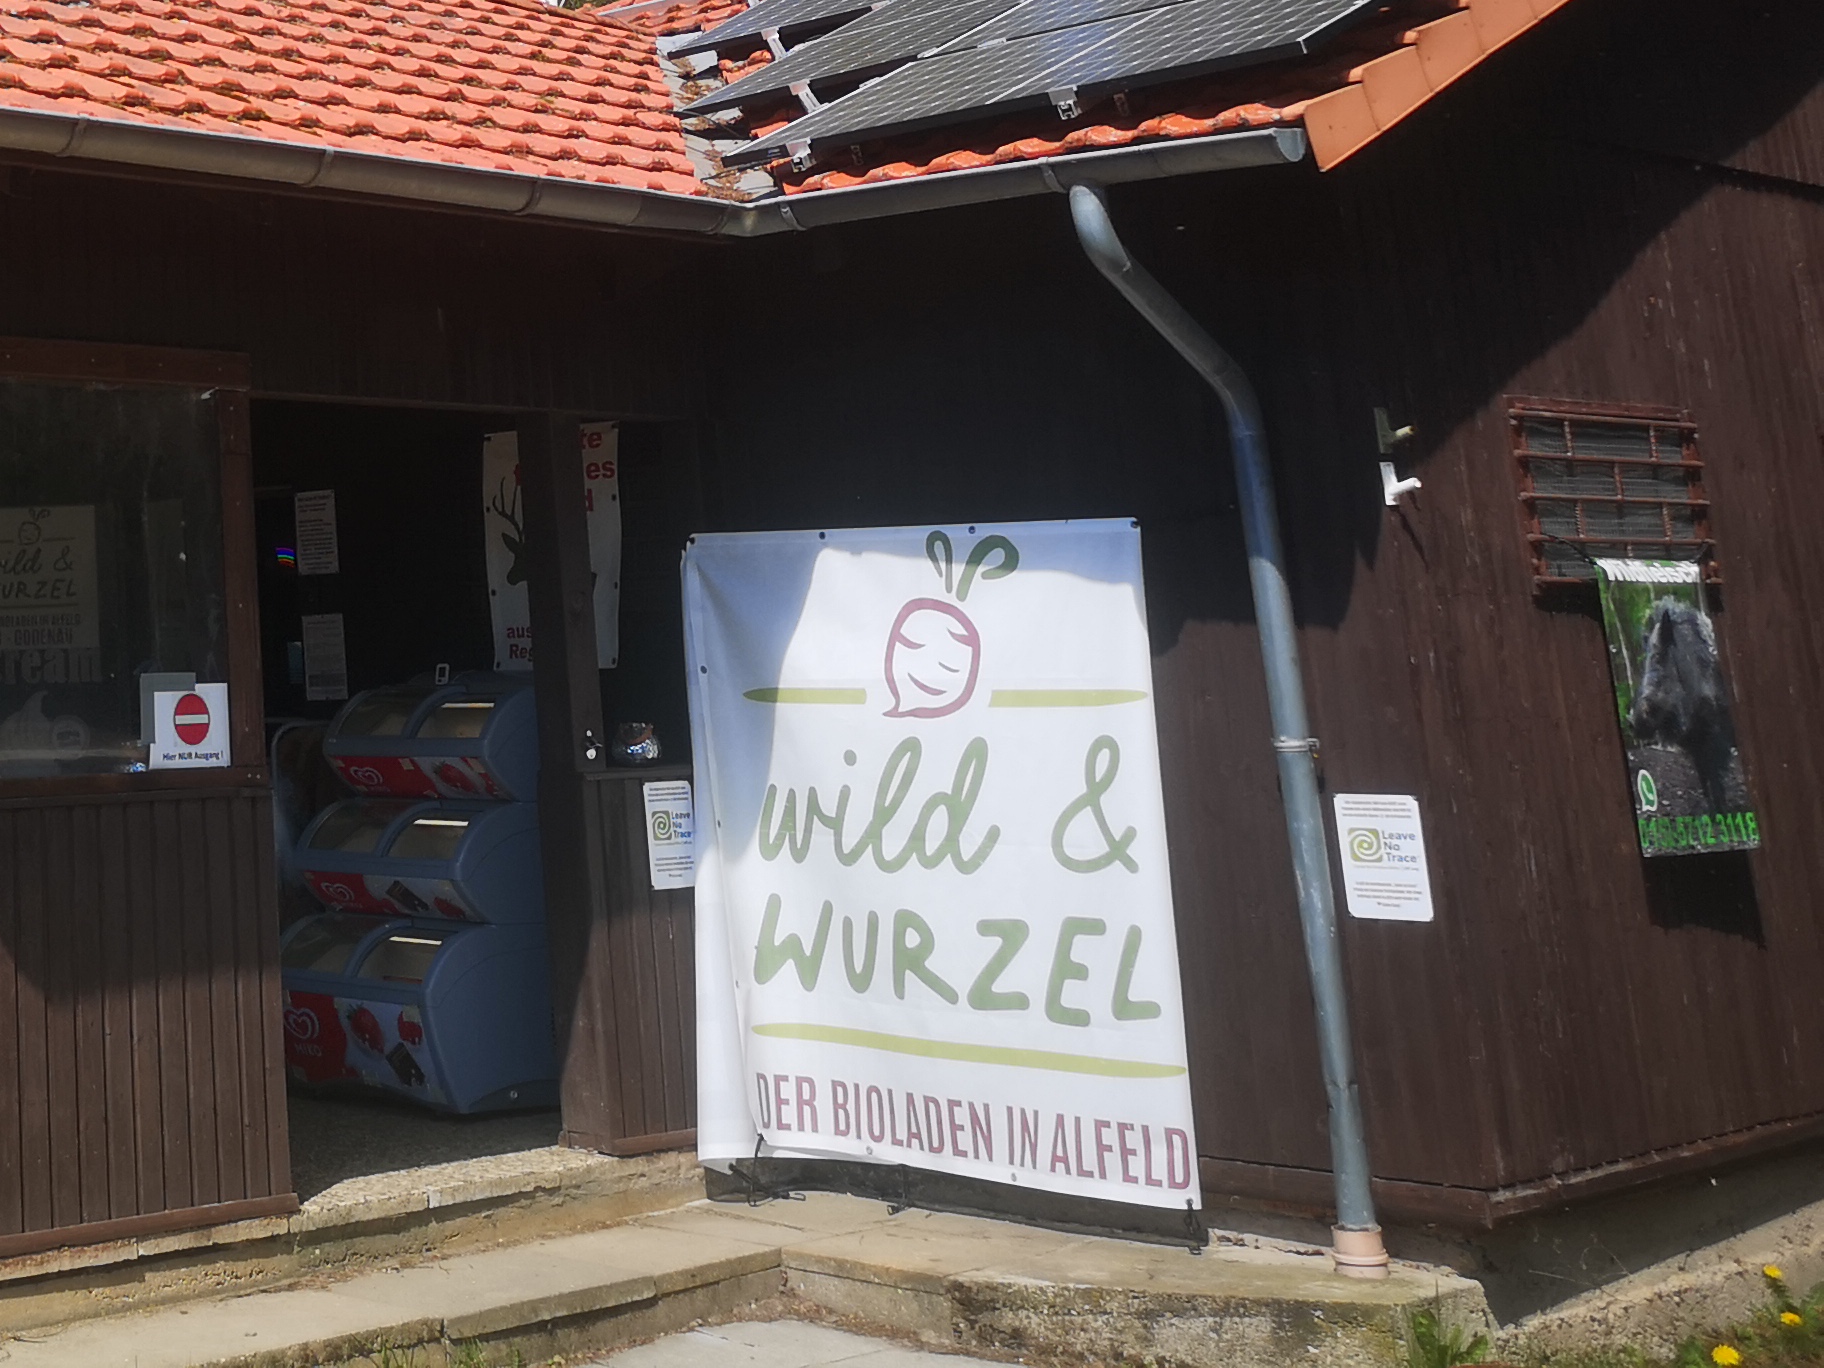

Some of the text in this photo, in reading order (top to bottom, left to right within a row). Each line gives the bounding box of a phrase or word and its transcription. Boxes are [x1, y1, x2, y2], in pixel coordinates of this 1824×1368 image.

[53, 545, 73, 571] &
[162, 752, 177, 761] Hier
[178, 752, 193, 760] NUR
[194, 751, 220, 761] Ausgang
[758, 734, 1140, 876] wild &
[671, 811, 691, 820] Leave
[672, 821, 683, 829] No
[673, 830, 692, 839] Trace
[1381, 830, 1416, 841] Leave
[1383, 841, 1401, 851] No
[1385, 852, 1418, 863] Trace
[752, 892, 1163, 1028] WURZEL
[755, 1071, 1194, 1192] DER BIOLADEN IN ALFELD
